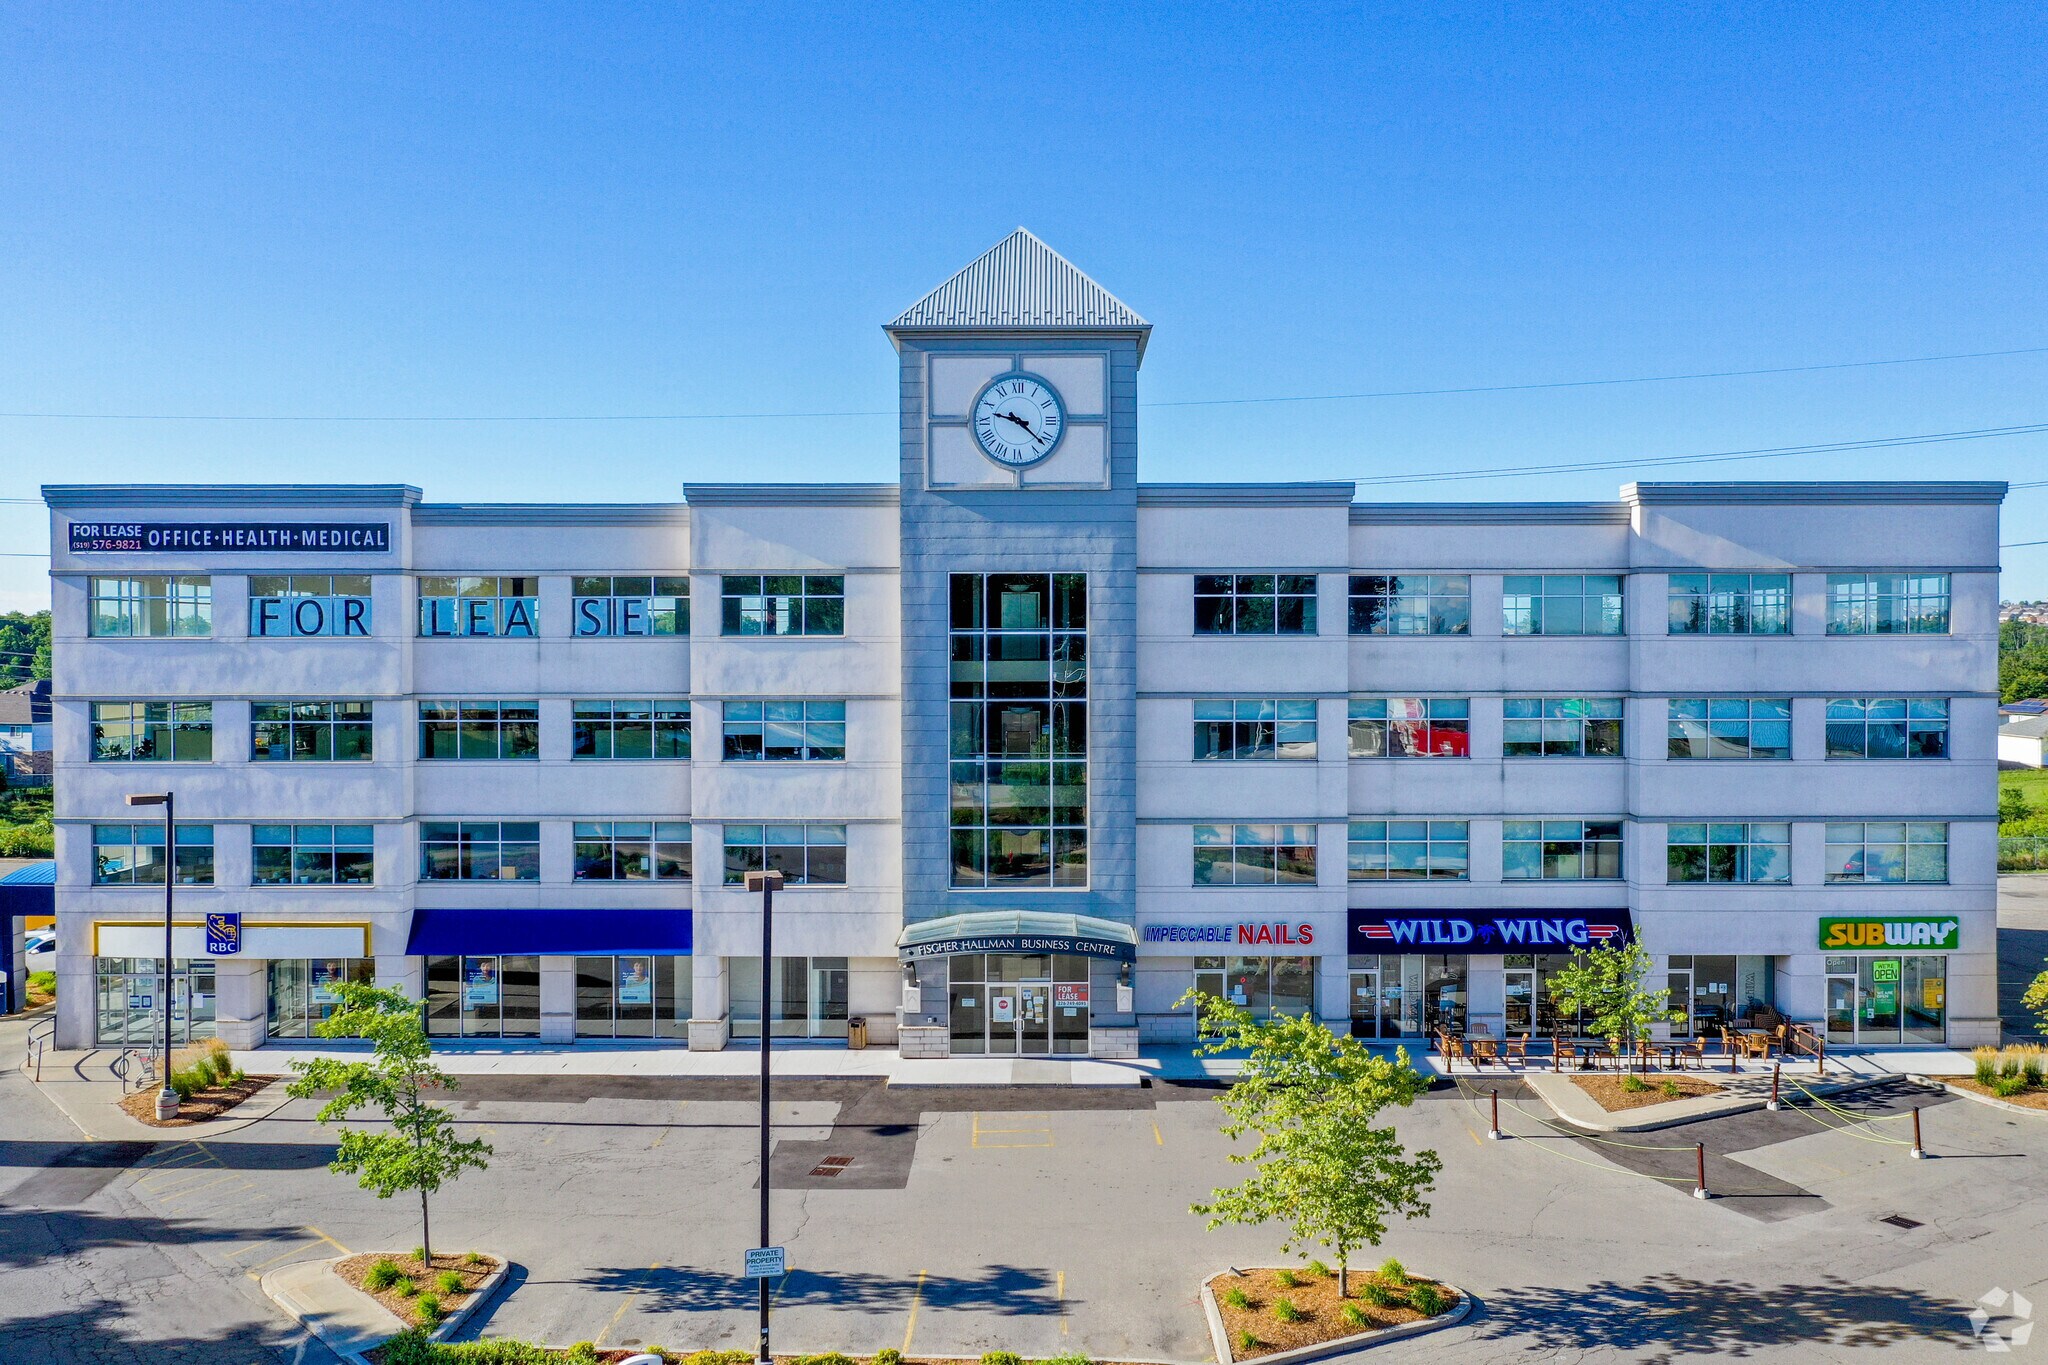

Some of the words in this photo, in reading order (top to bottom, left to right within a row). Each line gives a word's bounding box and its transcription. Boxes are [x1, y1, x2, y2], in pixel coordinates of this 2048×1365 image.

[1012, 382, 1024, 393] XII
[1041, 400, 1052, 409] II
[1045, 416, 1056, 425] III
[73, 525, 100, 537] FOR
[103, 525, 142, 537] LEASE
[73, 541, 90, 549] (519)
[92, 540, 142, 550] 576-9821
[260, 599, 369, 636] FOR
[1144, 926, 1233, 943] IMPECCABLE
[1237, 924, 1315, 945] NAILS
[1386, 919, 1474, 943] WILD
[1494, 919, 1589, 943] WING
[1824, 920, 1958, 947] SUBWAY
[210, 942, 236, 952] RBC
[918, 941, 959, 955] FISCHER
[962, 939, 1015, 950] HALLMAN
[1021, 939, 1070, 950] BUSINESS
[1075, 941, 1116, 955] CENTRE
[1874, 969, 1898, 980] OPEN
[1058, 985, 1072, 993] FOR
[1058, 992, 1079, 1000] LEASE
[750, 1250, 779, 1258] PRIVATE
[746, 1256, 783, 1265] PROPERTY
